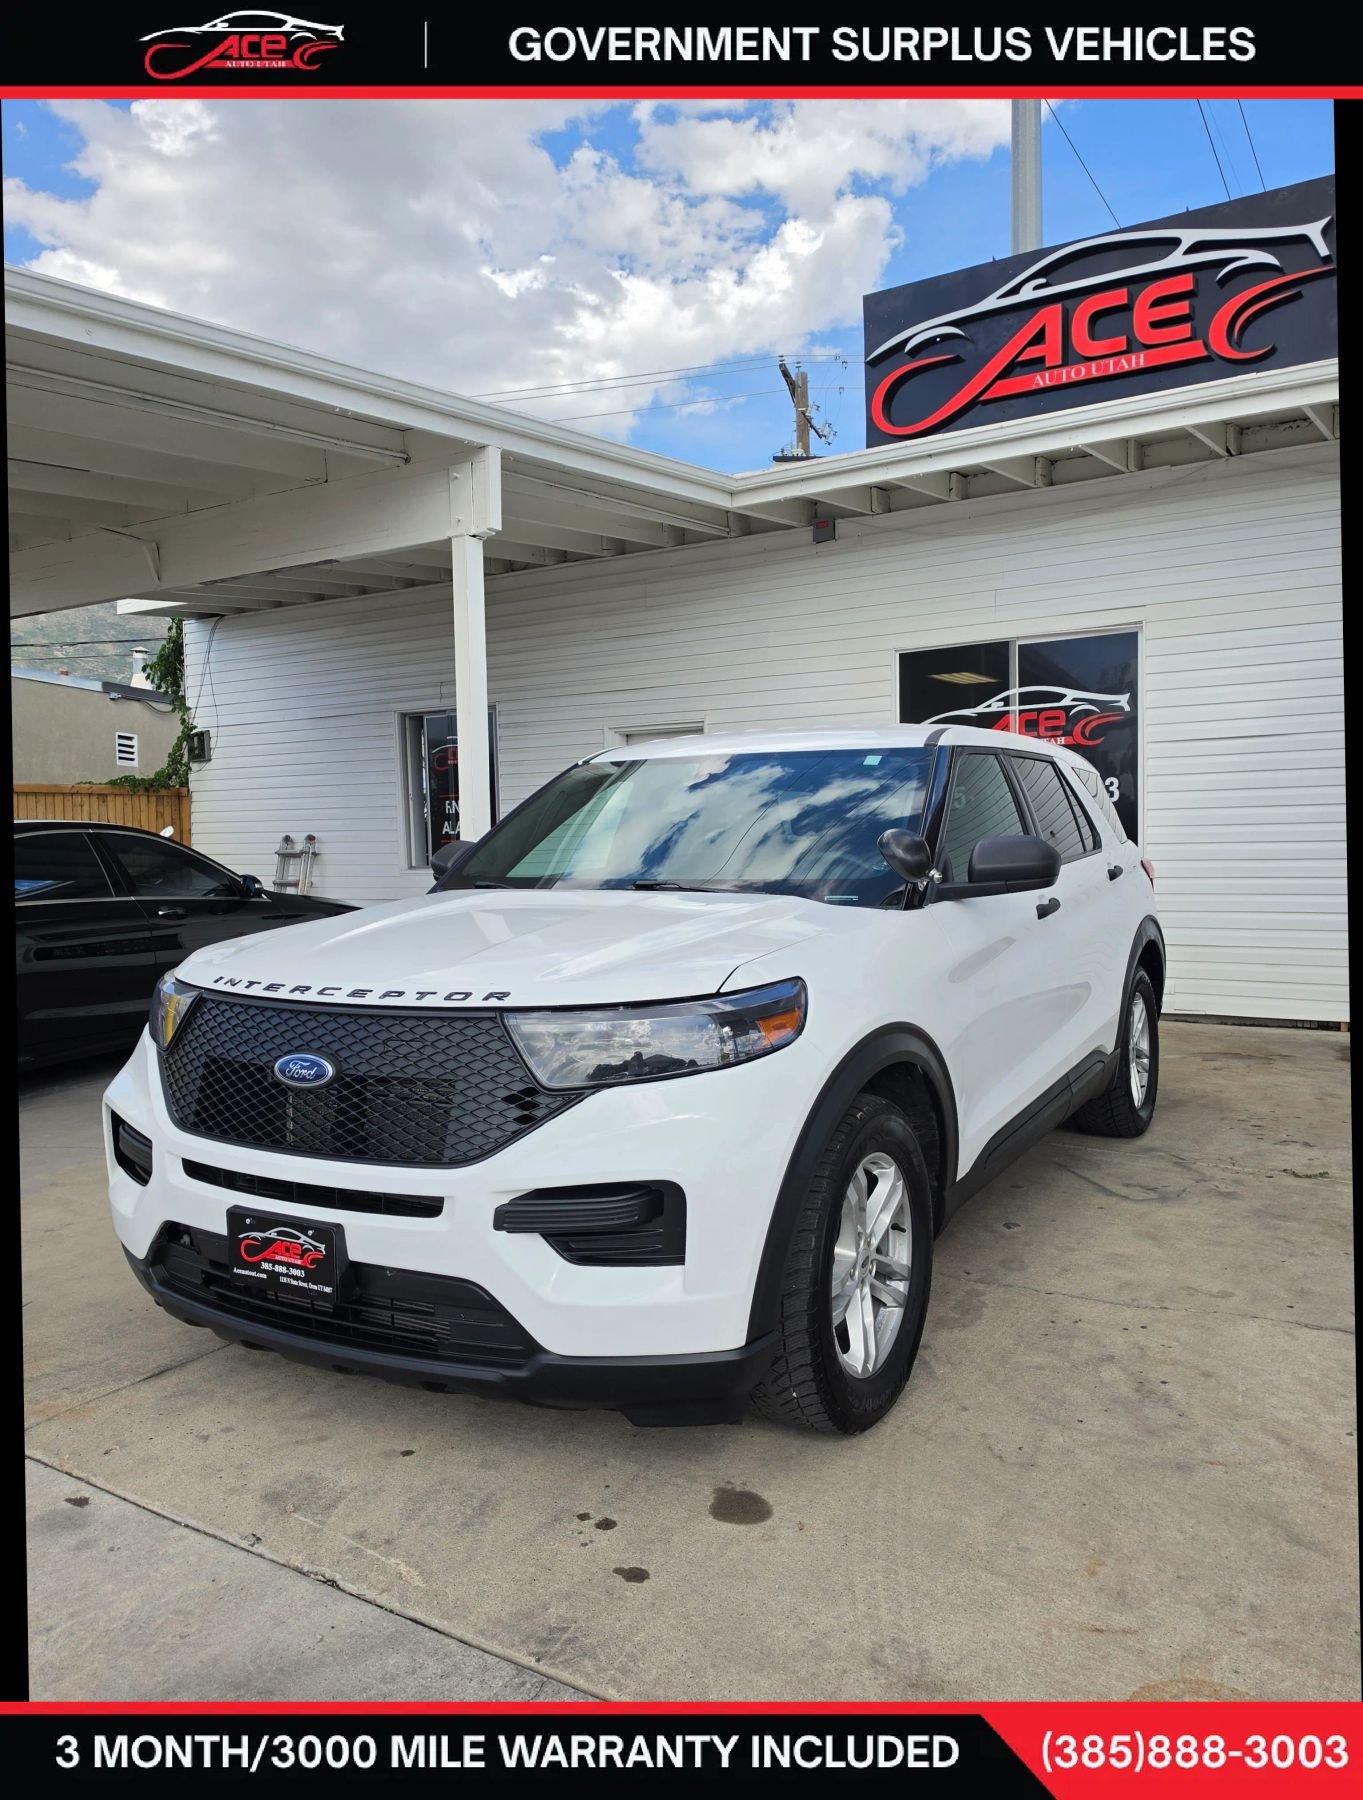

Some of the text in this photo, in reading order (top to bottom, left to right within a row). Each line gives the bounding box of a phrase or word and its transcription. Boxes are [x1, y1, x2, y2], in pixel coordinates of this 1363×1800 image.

[1000, 272, 1197, 372] ACE
[1031, 352, 1146, 389] AUTO UTAH
[212, 975, 513, 1002] INTERCEPTOR
[285, 1060, 317, 1081] Ford
[260, 1261, 306, 1278] 385-888-3003
